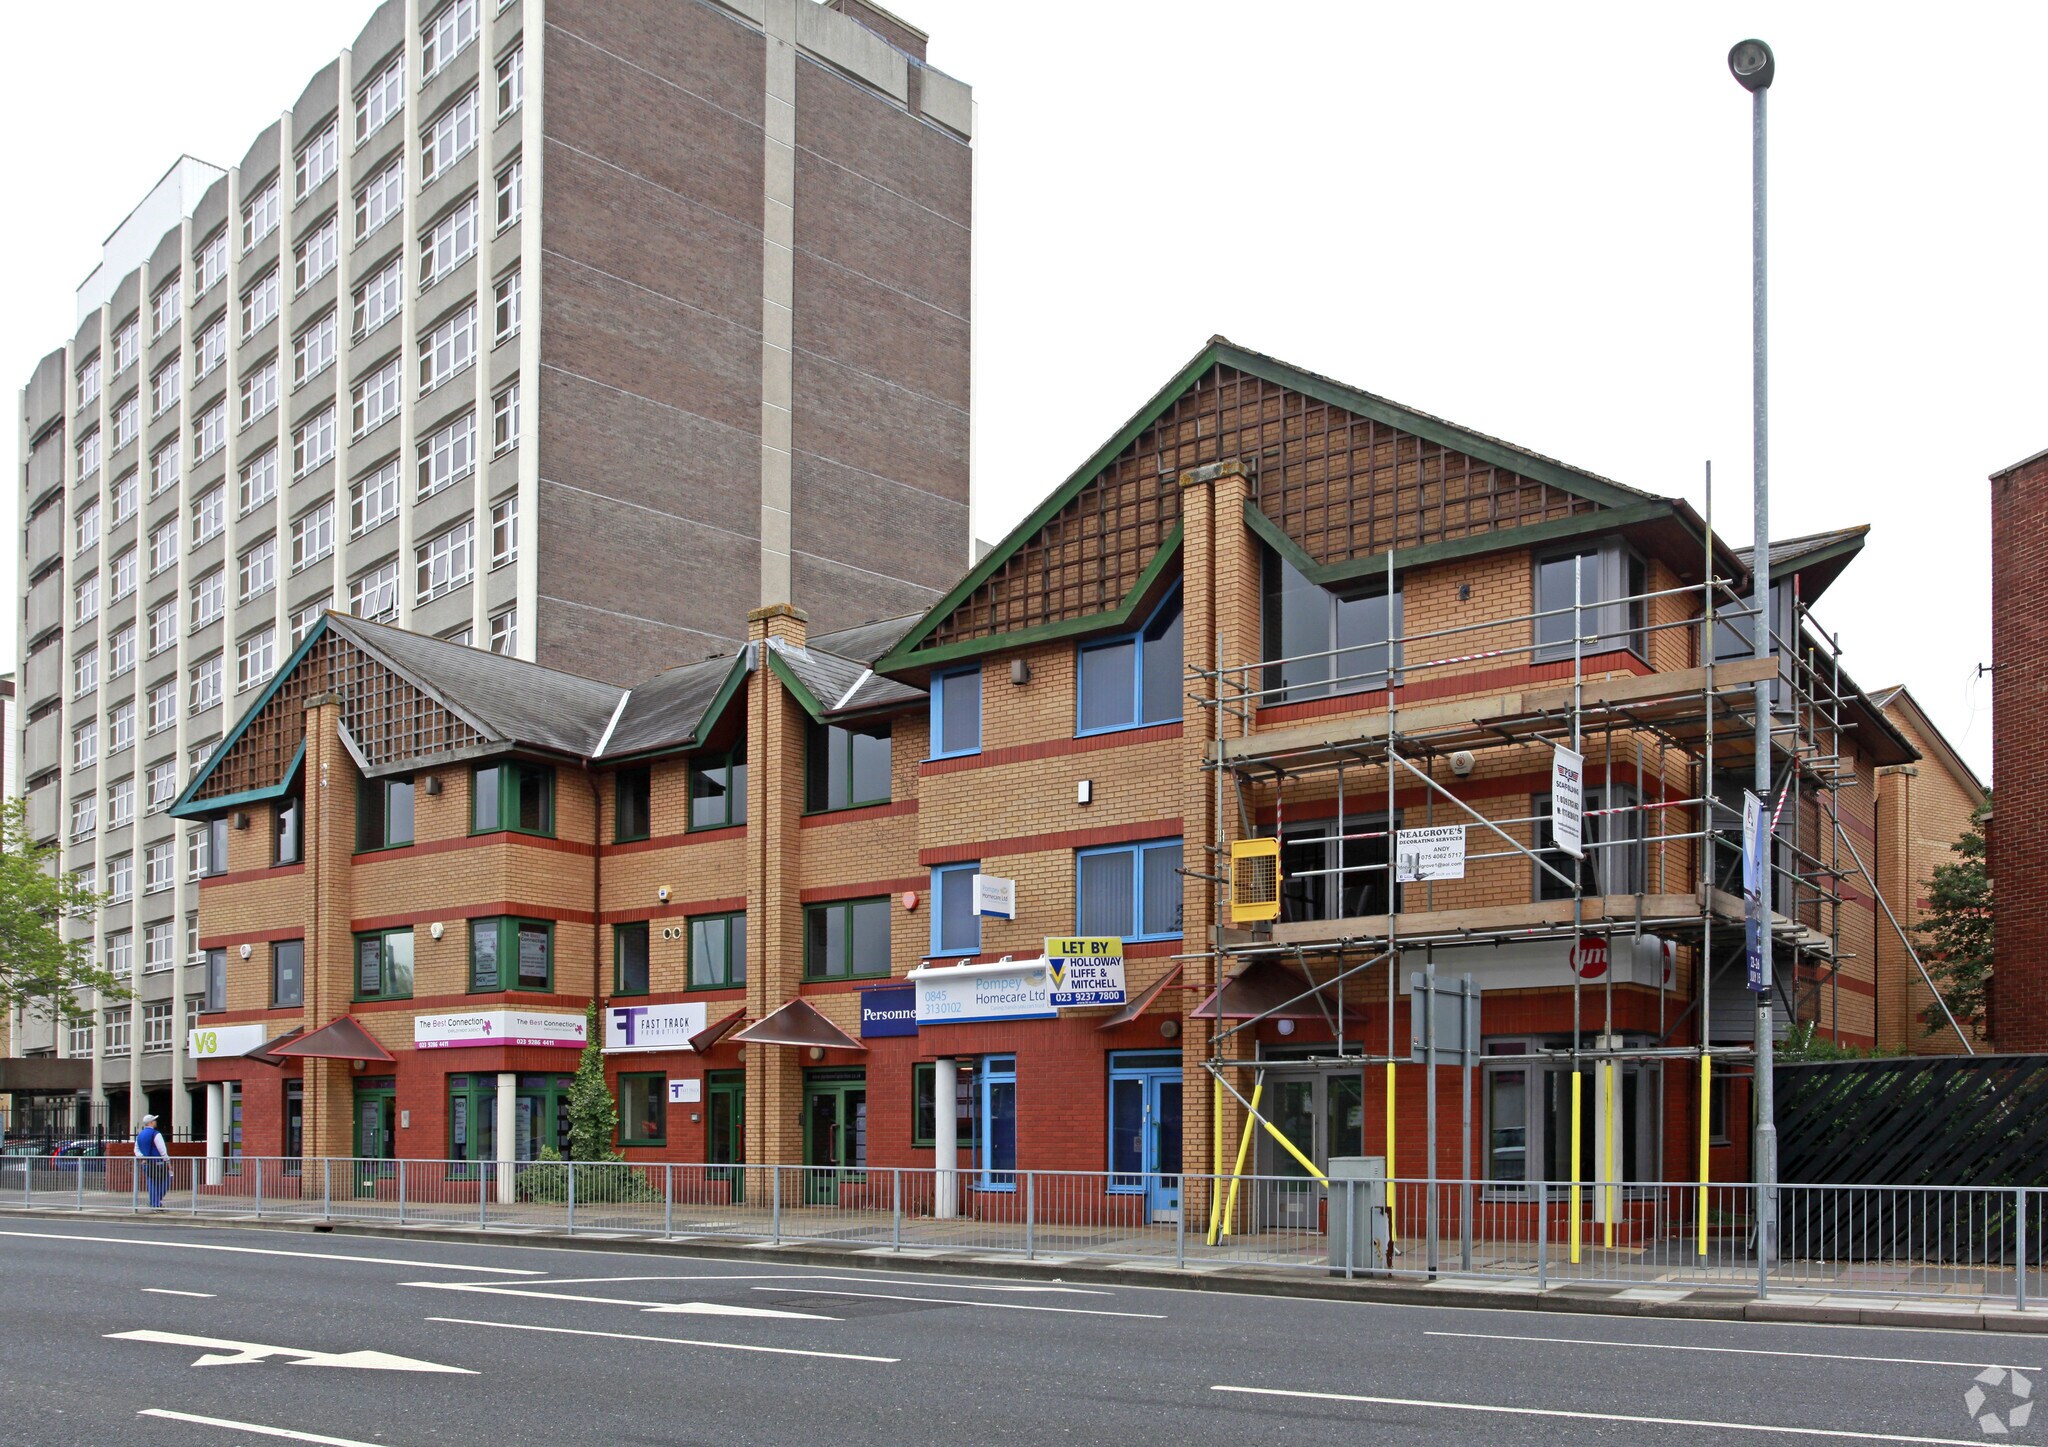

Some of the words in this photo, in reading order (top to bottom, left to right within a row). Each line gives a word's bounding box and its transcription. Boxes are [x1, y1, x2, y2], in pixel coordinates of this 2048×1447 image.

[1399, 827, 1463, 839] NEALGROVE'S
[1062, 941, 1085, 954] LET
[1091, 941, 1109, 954] BY
[1070, 957, 1121, 967] HOLLOWAY
[1070, 968, 1096, 978] ILIFFE
[1100, 968, 1107, 977] &
[976, 977, 1022, 991] Pompey
[1071, 979, 1117, 989] MITCHELL
[924, 990, 947, 1002] 0845
[976, 993, 1027, 1005] Homecare
[1029, 989, 1046, 1002] Ltd
[1055, 993, 1072, 1002] 023
[1075, 992, 1096, 1001] 9237
[1099, 991, 1119, 1000] 7800
[419, 1020, 431, 1028] The
[432, 1019, 447, 1028] Best
[447, 1017, 484, 1027] Connection
[517, 1018, 528, 1026] The
[543, 1019, 577, 1028] Connection
[641, 1018, 660, 1029] FAST
[664, 1017, 690, 1028] TRACK
[641, 1027, 690, 1036] PROMOTIONS
